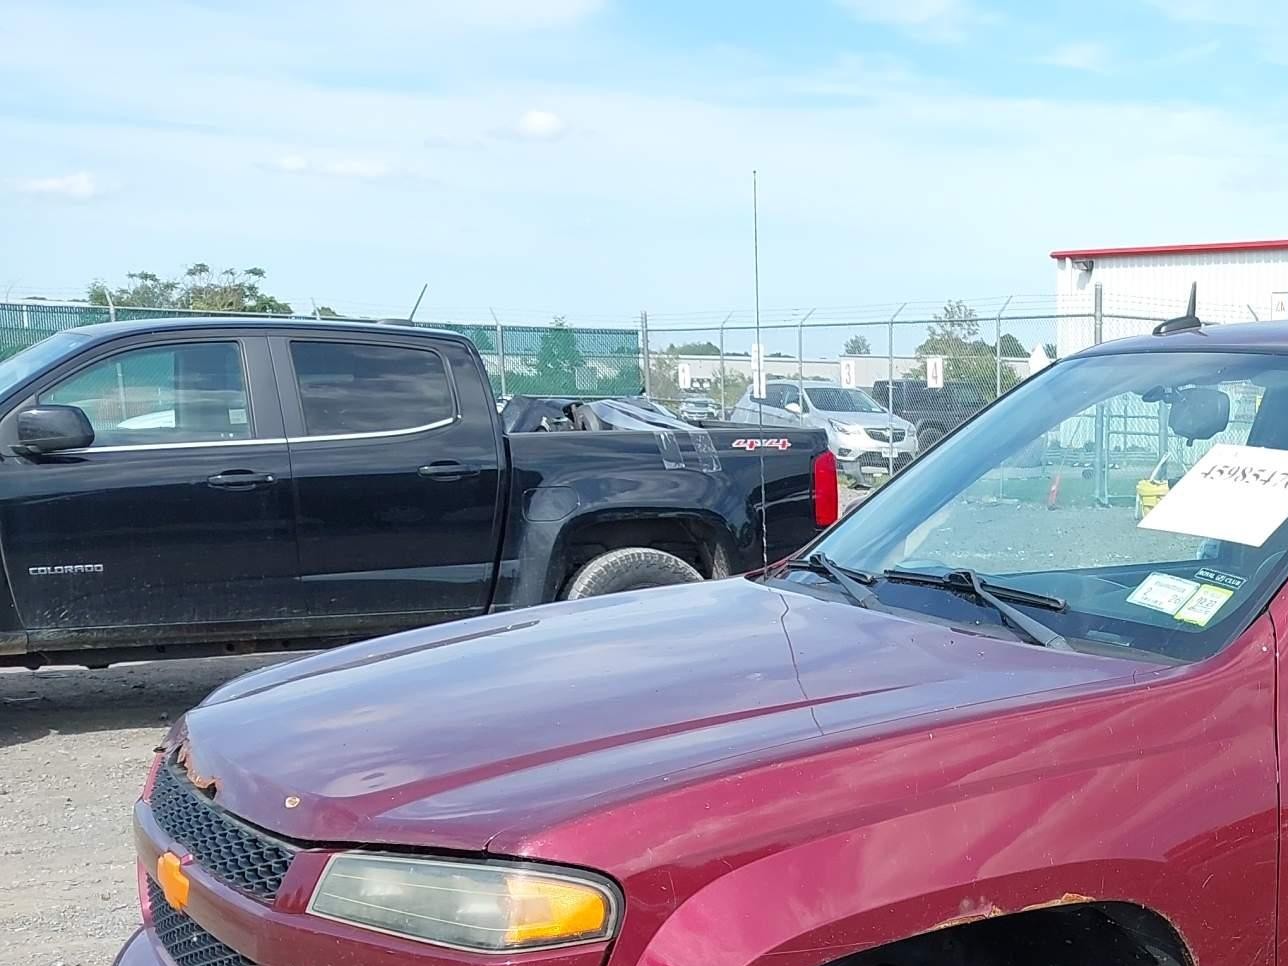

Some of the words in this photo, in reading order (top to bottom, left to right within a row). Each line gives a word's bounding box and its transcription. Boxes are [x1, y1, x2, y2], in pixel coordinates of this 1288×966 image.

[844, 364, 852, 385] 3
[931, 363, 939, 384] 4
[28, 563, 104, 576] COLORADO
